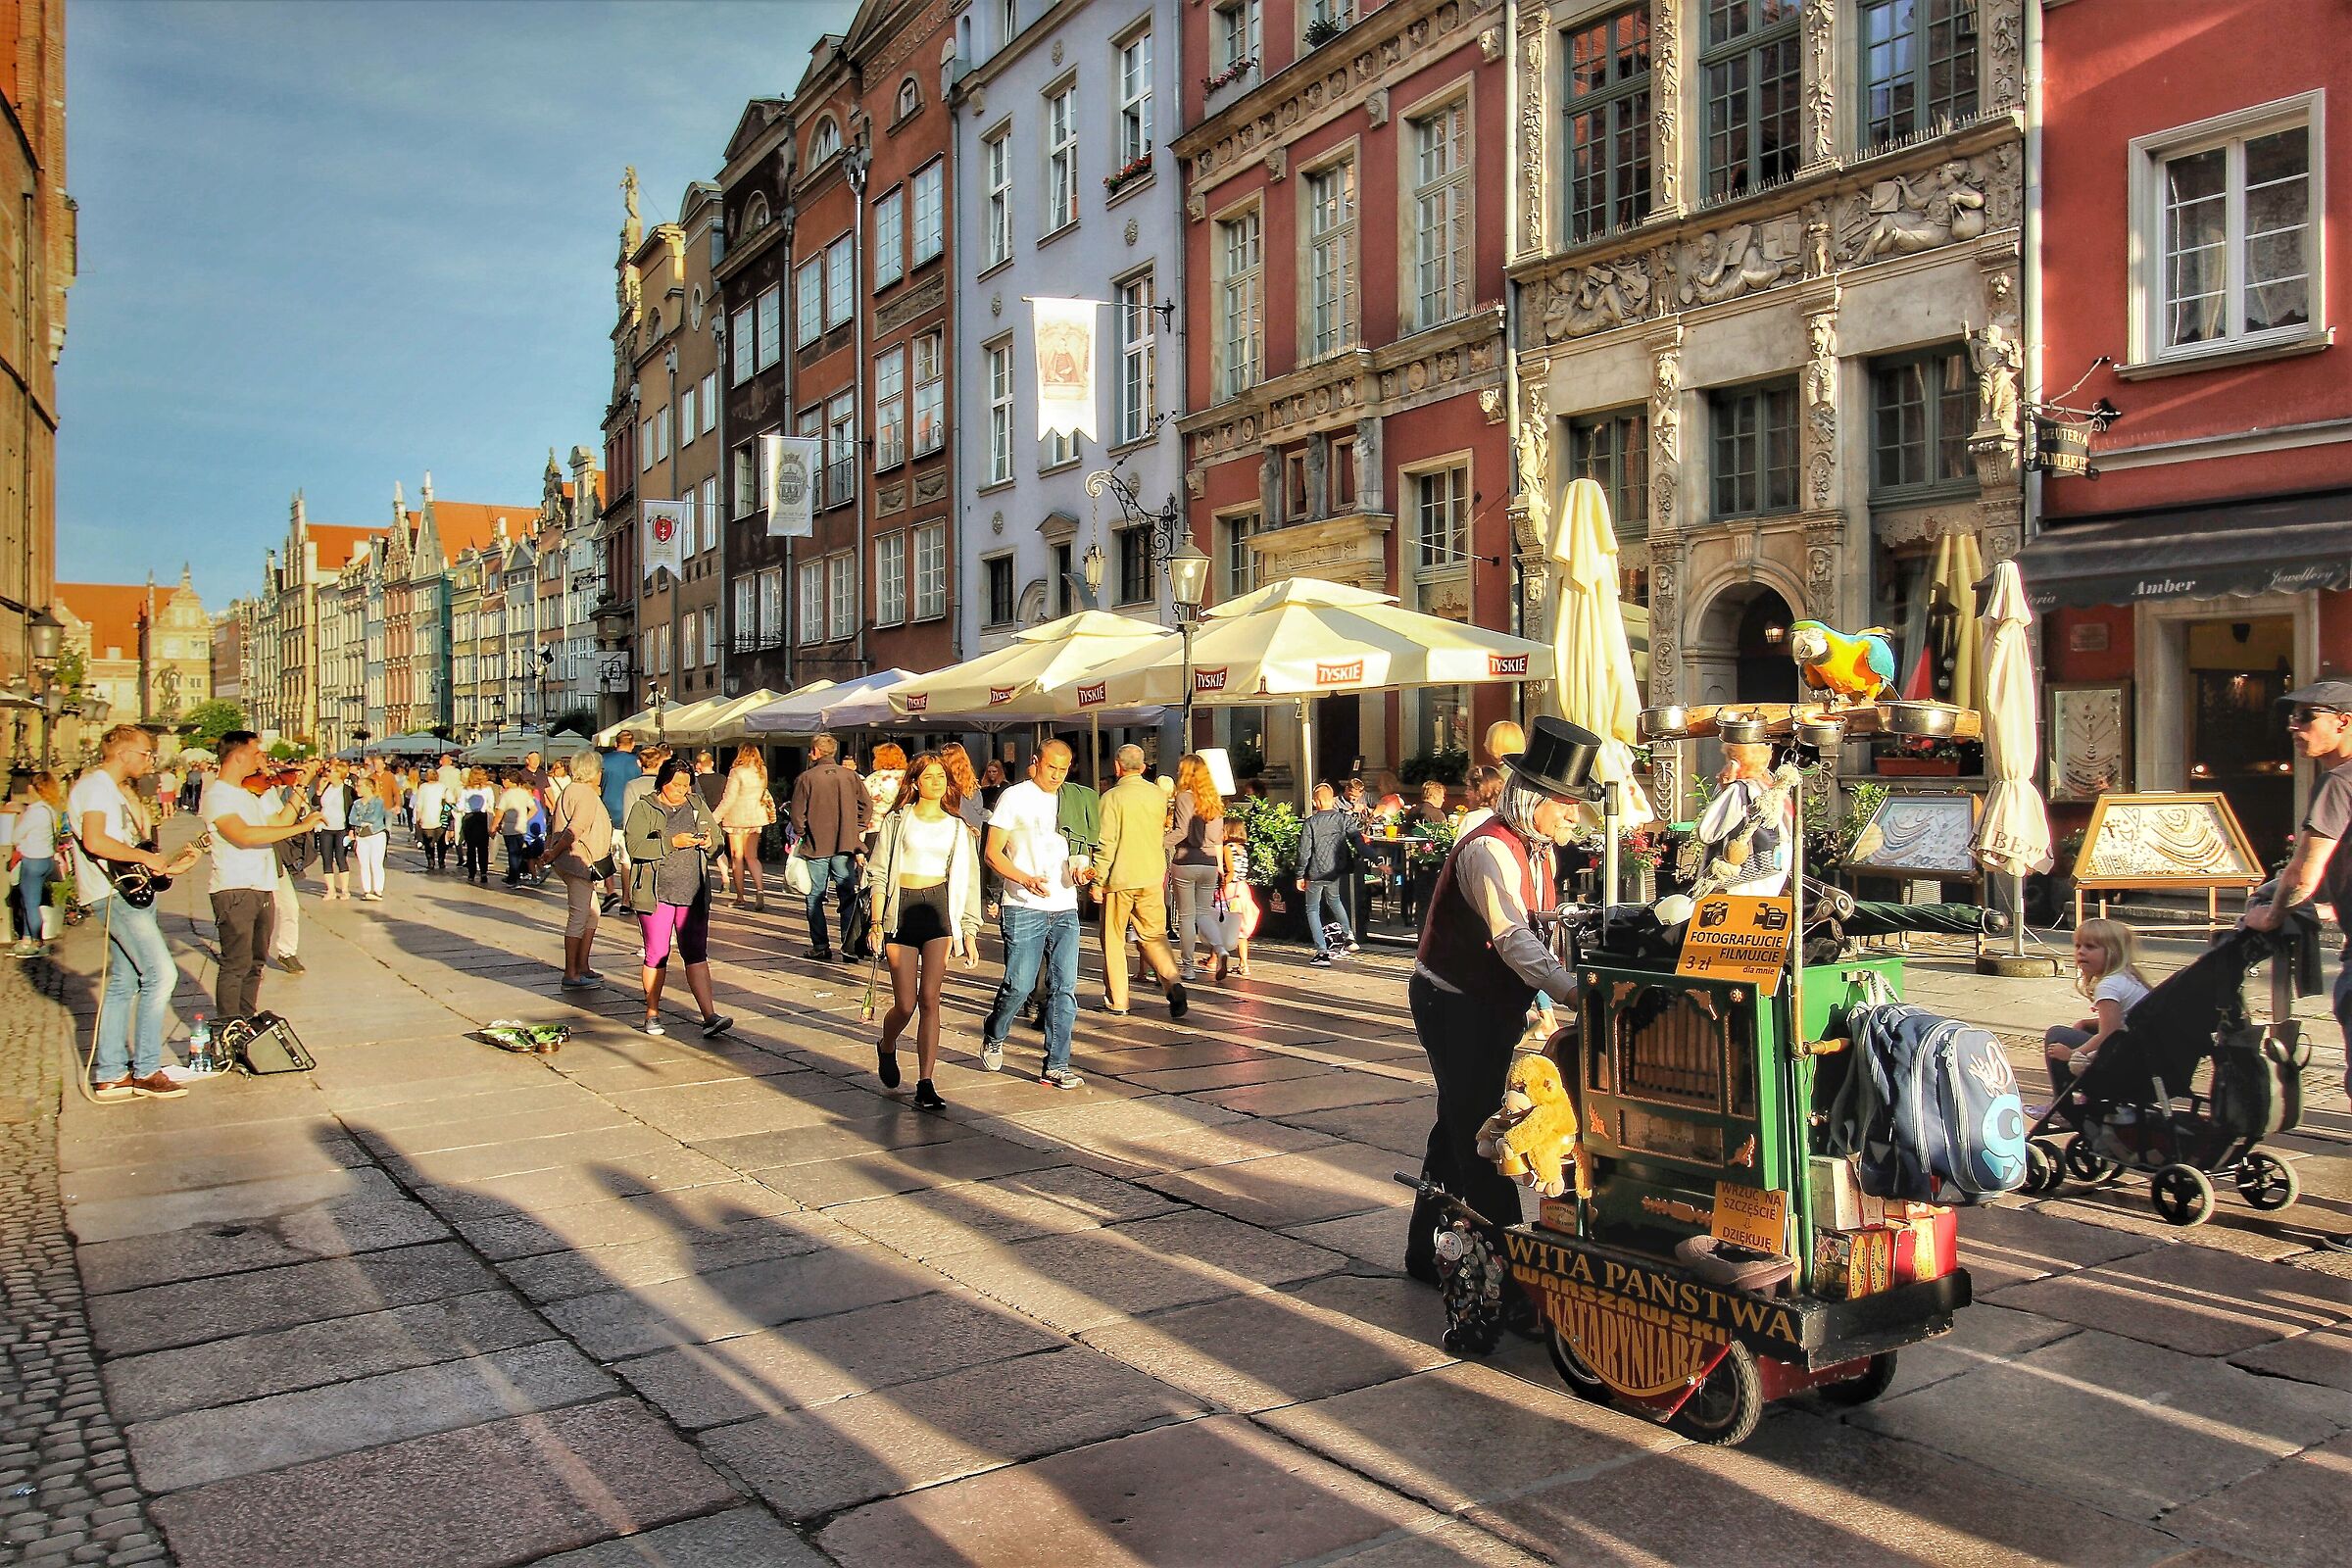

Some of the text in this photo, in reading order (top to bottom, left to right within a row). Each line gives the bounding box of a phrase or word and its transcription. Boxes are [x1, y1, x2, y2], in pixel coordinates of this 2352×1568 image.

[2039, 451, 2087, 470] AMBER
[2131, 579, 2196, 595] Amber
[1318, 663, 1361, 683] TYSKIE
[1492, 658, 1526, 673] TYSKIE
[1196, 672, 1225, 689] TYSKIE
[907, 696, 927, 710] TYSKIE
[1079, 686, 1105, 704] TYSKIE
[1690, 931, 1784, 948] FOTOGRAFUJCIE
[1685, 956, 1713, 971] 3 zł
[1719, 948, 1780, 962] FILMUJCIE
[1742, 965, 1775, 975] dla mnie
[1765, 1192, 1782, 1207] NA
[1723, 1197, 1776, 1221] SZCZĘŚCIE
[1722, 1225, 1773, 1253] DZIĘKUJĘ
[1505, 1233, 1594, 1284] WITA
[1603, 1259, 1798, 1345] PAŃSTWA
[1512, 1263, 1728, 1345] WARSZAWSKI
[1544, 1290, 1705, 1390] KATARYNIARZ
